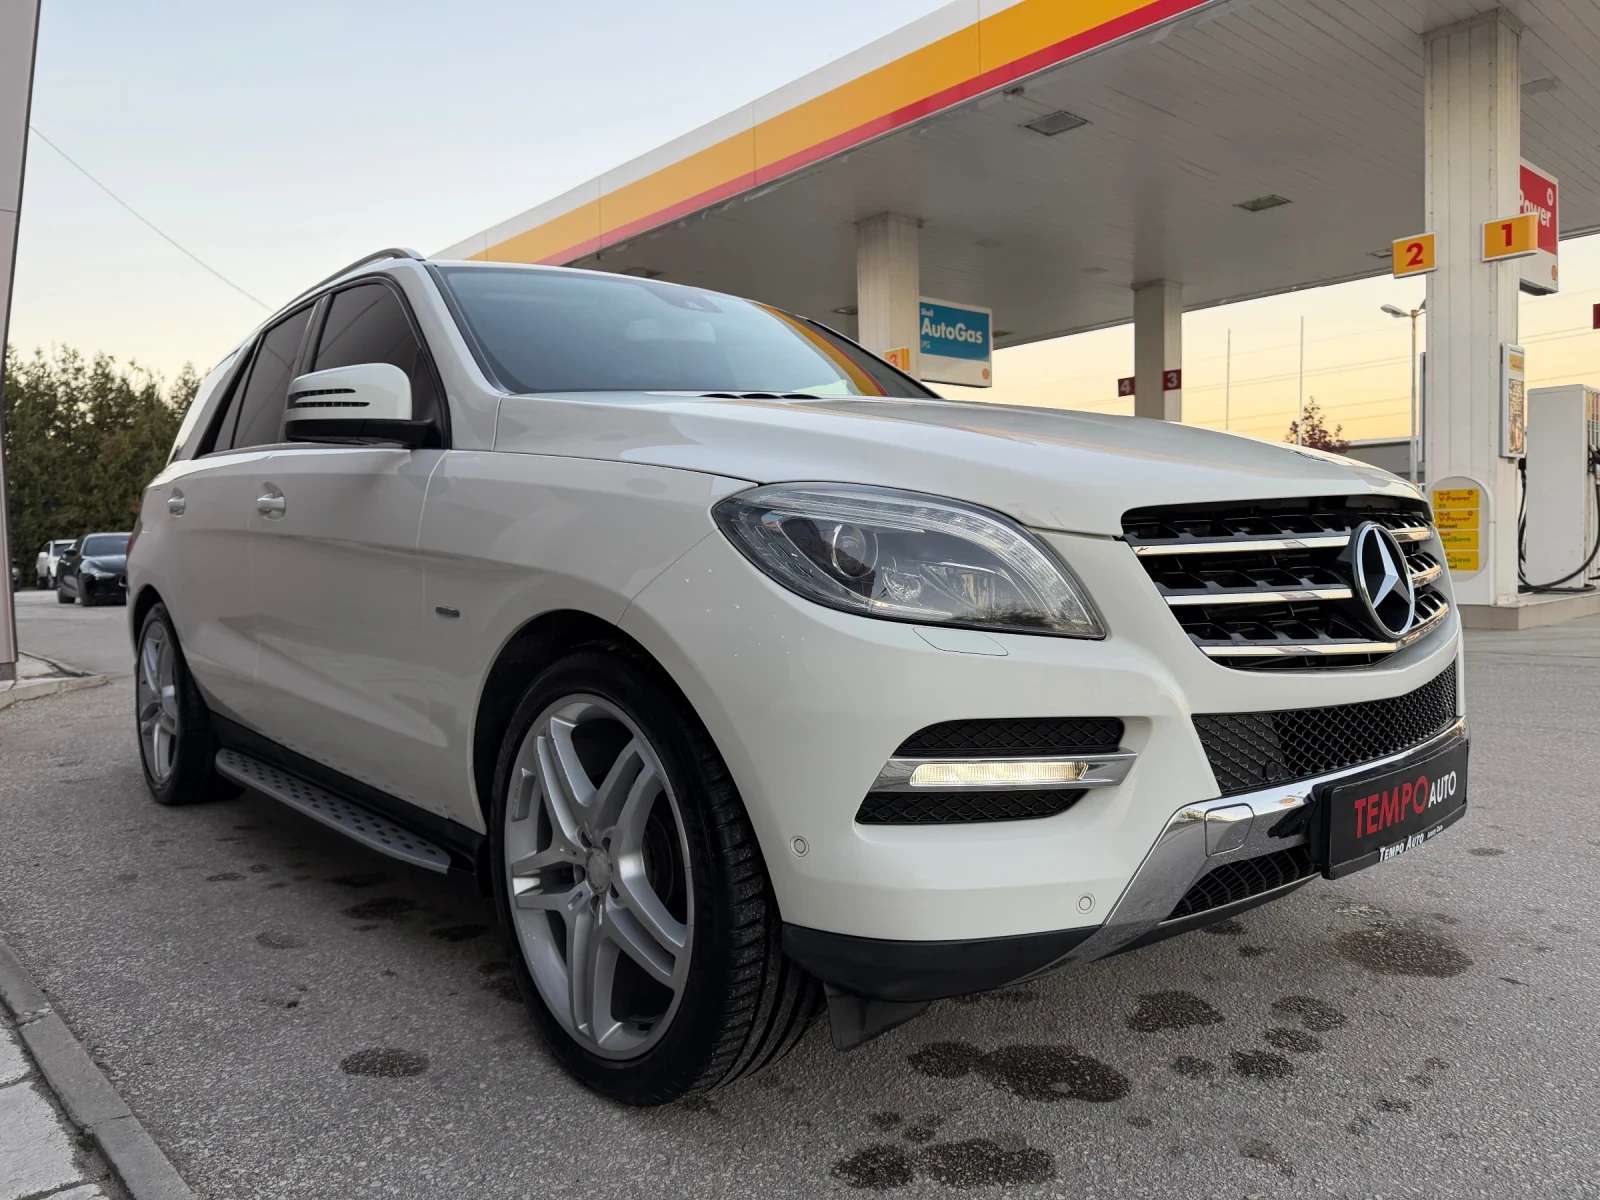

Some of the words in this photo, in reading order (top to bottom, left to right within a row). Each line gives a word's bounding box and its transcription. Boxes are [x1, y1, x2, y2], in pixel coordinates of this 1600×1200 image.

[1501, 223, 1513, 247] 1
[1406, 242, 1424, 267] 2
[920, 308, 934, 317] Shell
[920, 317, 983, 344] AutoGas
[890, 354, 898, 367] 3
[1120, 379, 1131, 394] 4
[1167, 372, 1178, 388] 3
[1354, 775, 1429, 839] TEMPO
[1428, 770, 1457, 808] AUTO
